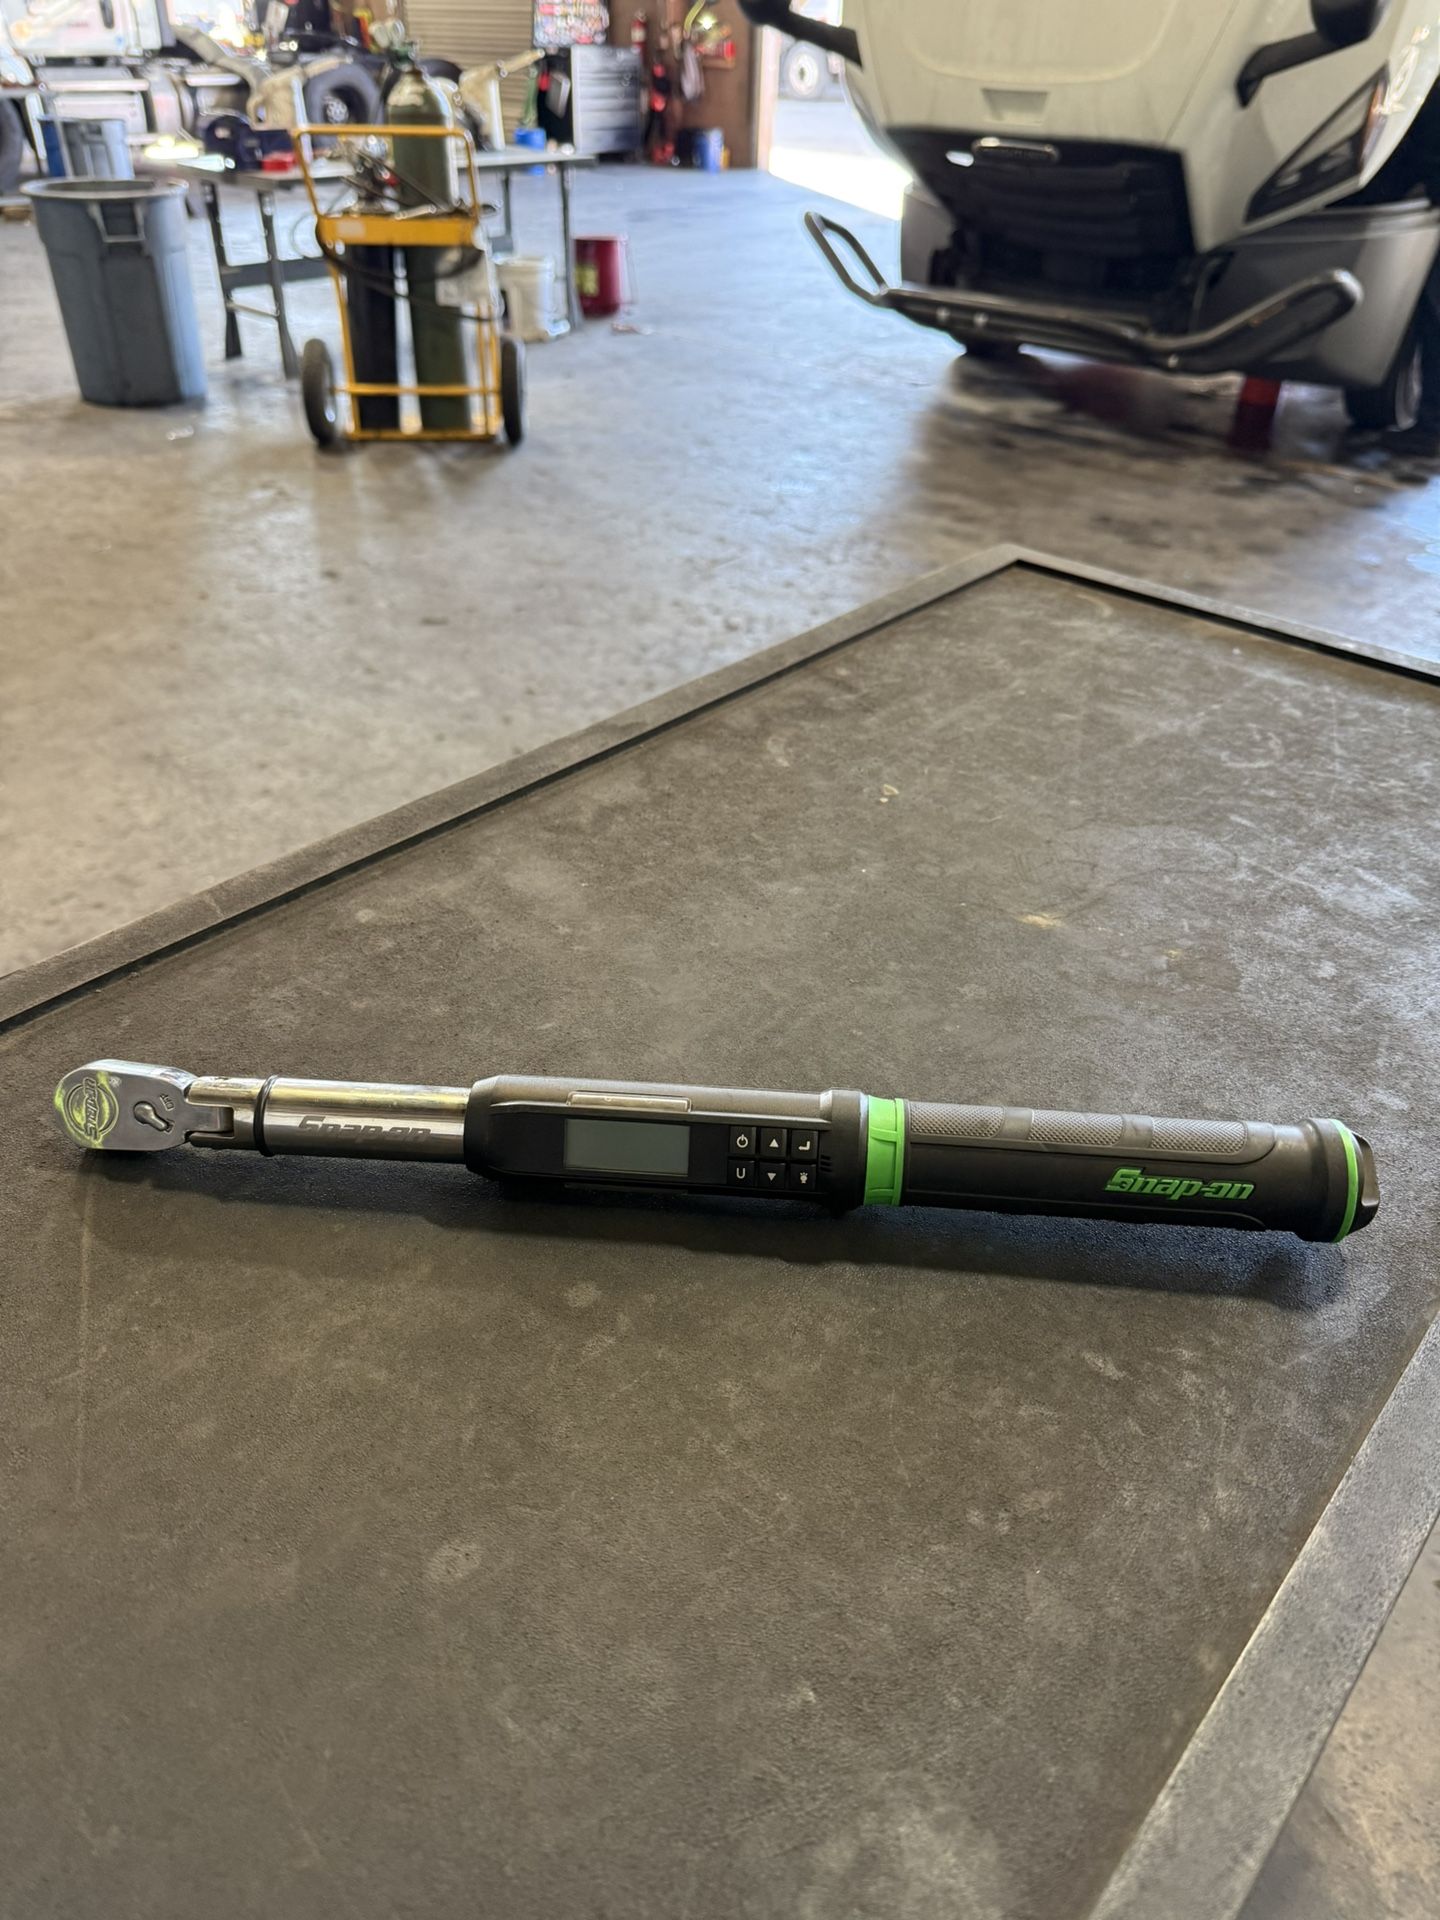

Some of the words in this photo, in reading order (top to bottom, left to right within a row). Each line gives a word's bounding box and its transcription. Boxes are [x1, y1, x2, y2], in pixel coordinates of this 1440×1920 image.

[299, 1115, 432, 1143] Snap-on
[736, 1168, 746, 1179] U
[1104, 1167, 1255, 1200] Snap-on
